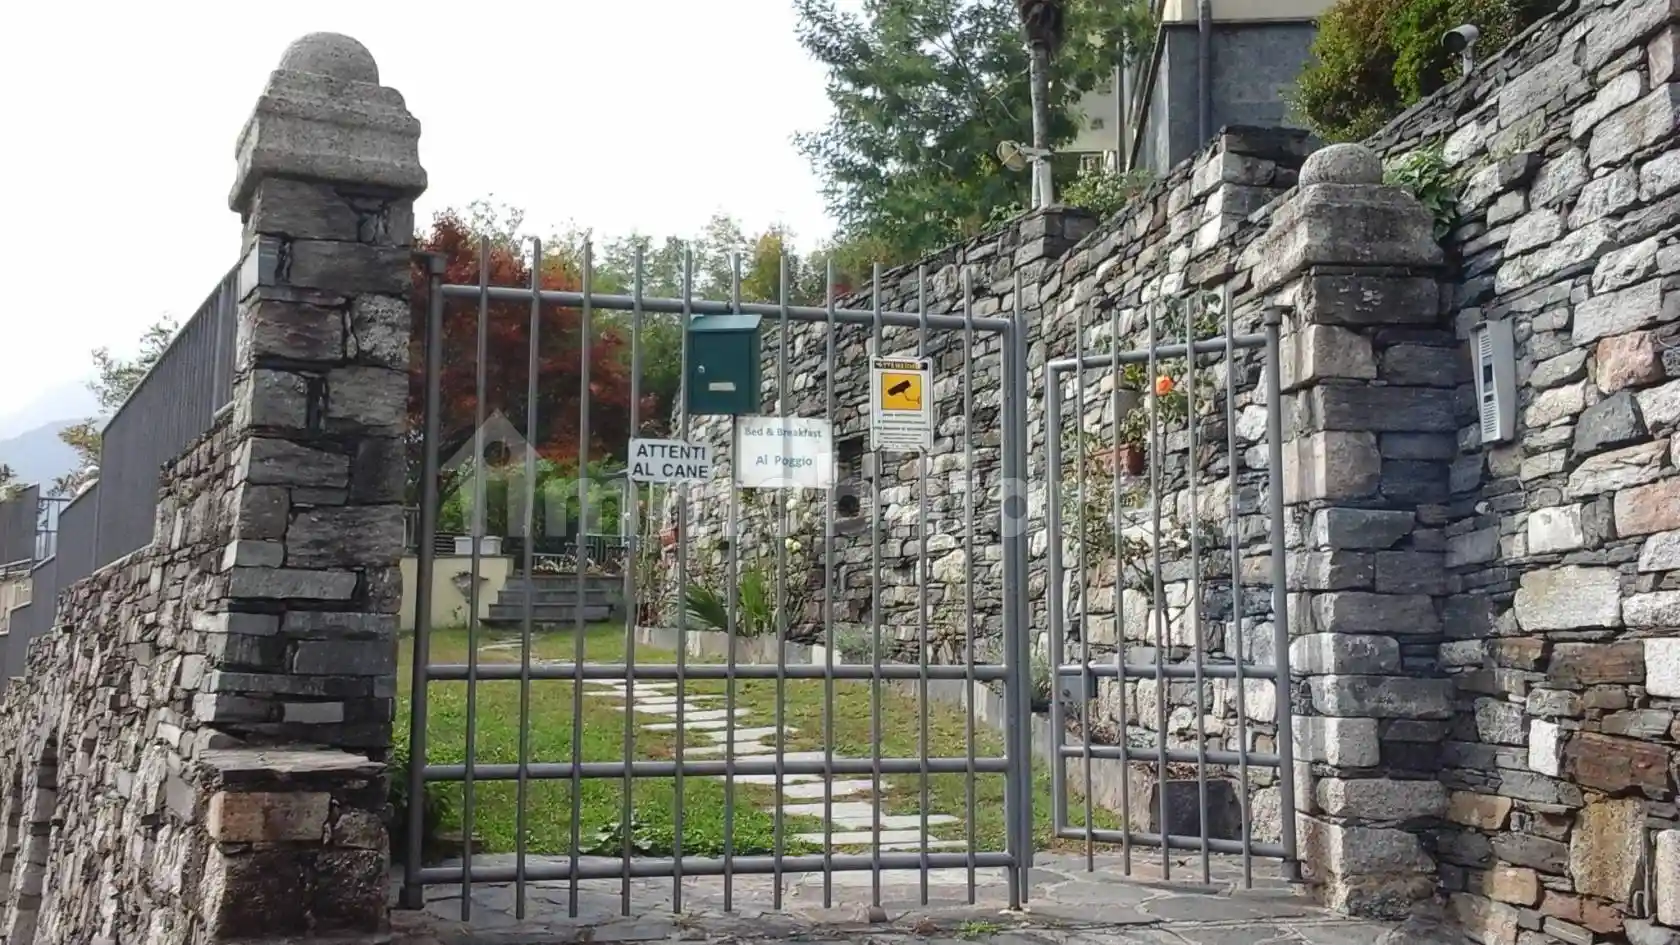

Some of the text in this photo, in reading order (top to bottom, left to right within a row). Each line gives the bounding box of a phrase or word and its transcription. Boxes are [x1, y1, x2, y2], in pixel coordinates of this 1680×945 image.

[744, 427, 822, 438] Bed & Breakfast
[637, 443, 706, 460] ATTENTI
[774, 455, 813, 468] Poggio
[632, 462, 709, 478] AL CANE
